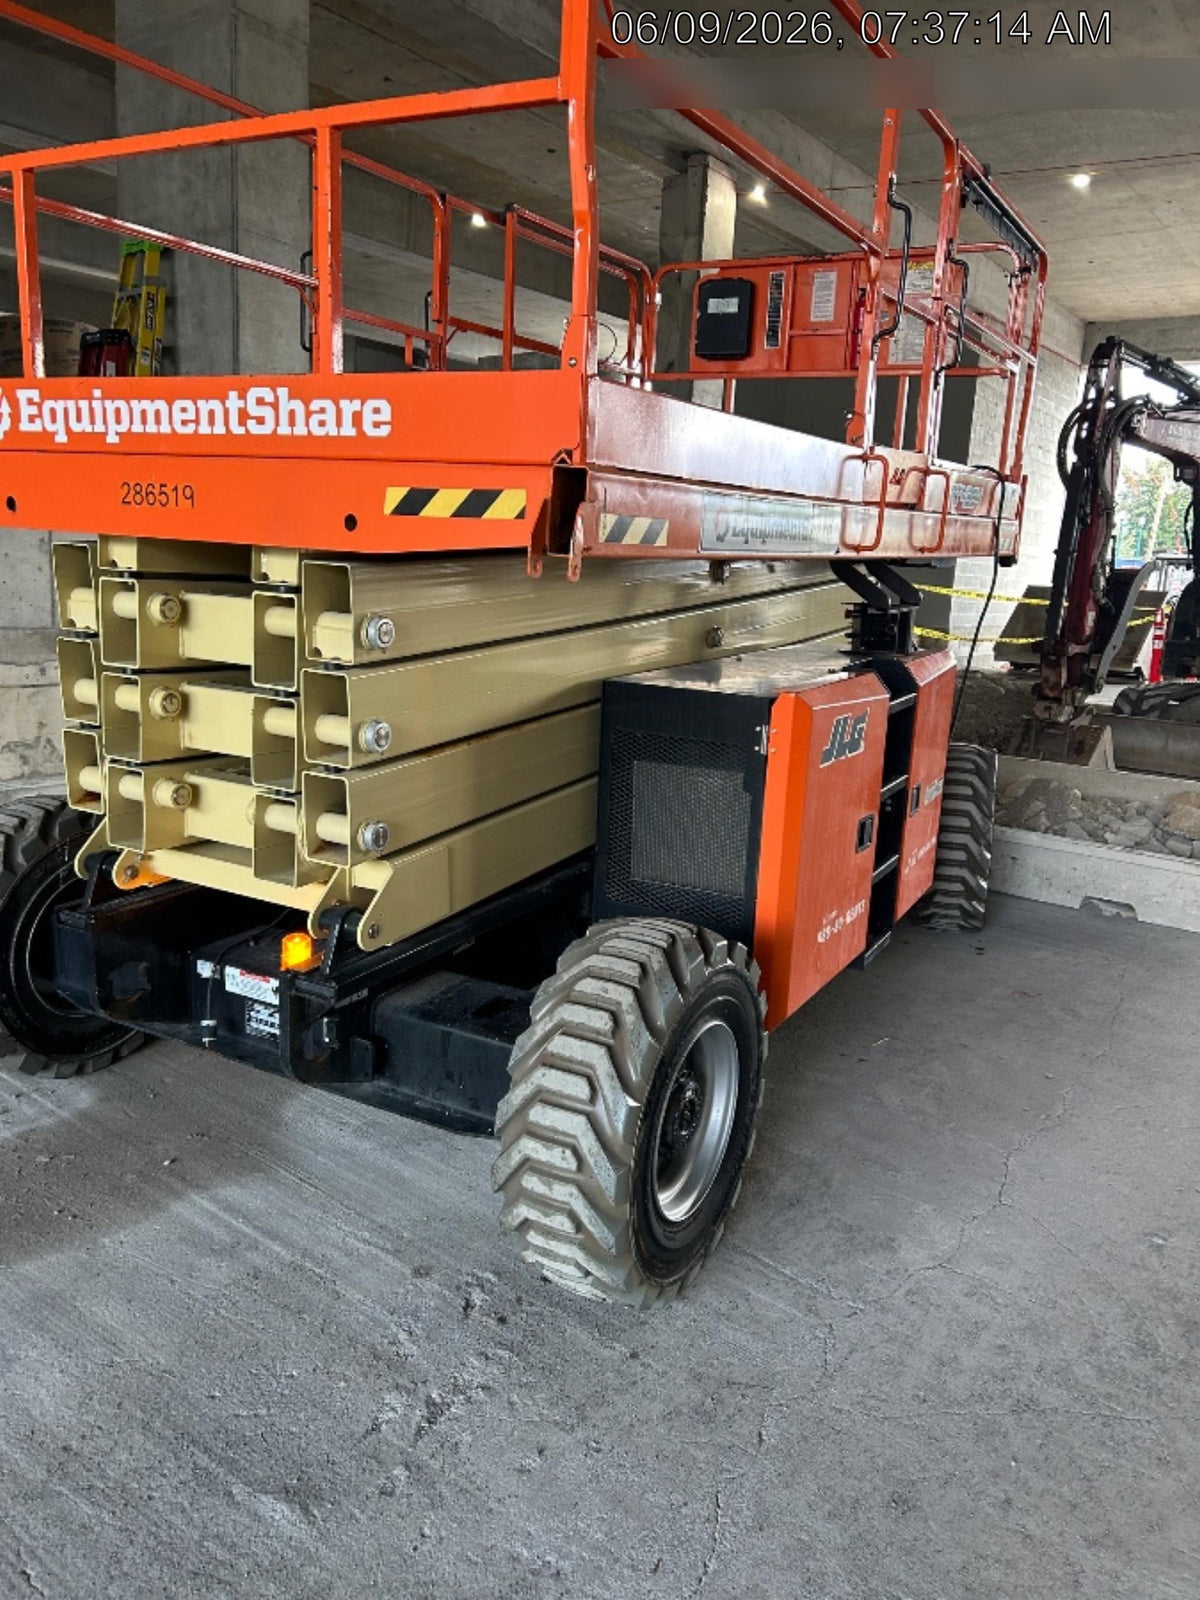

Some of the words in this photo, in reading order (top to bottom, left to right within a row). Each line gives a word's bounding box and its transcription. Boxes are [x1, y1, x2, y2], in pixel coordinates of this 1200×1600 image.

[15, 387, 392, 443] EquipmentShare
[120, 481, 195, 508] 286519
[819, 707, 869, 768] JLG
